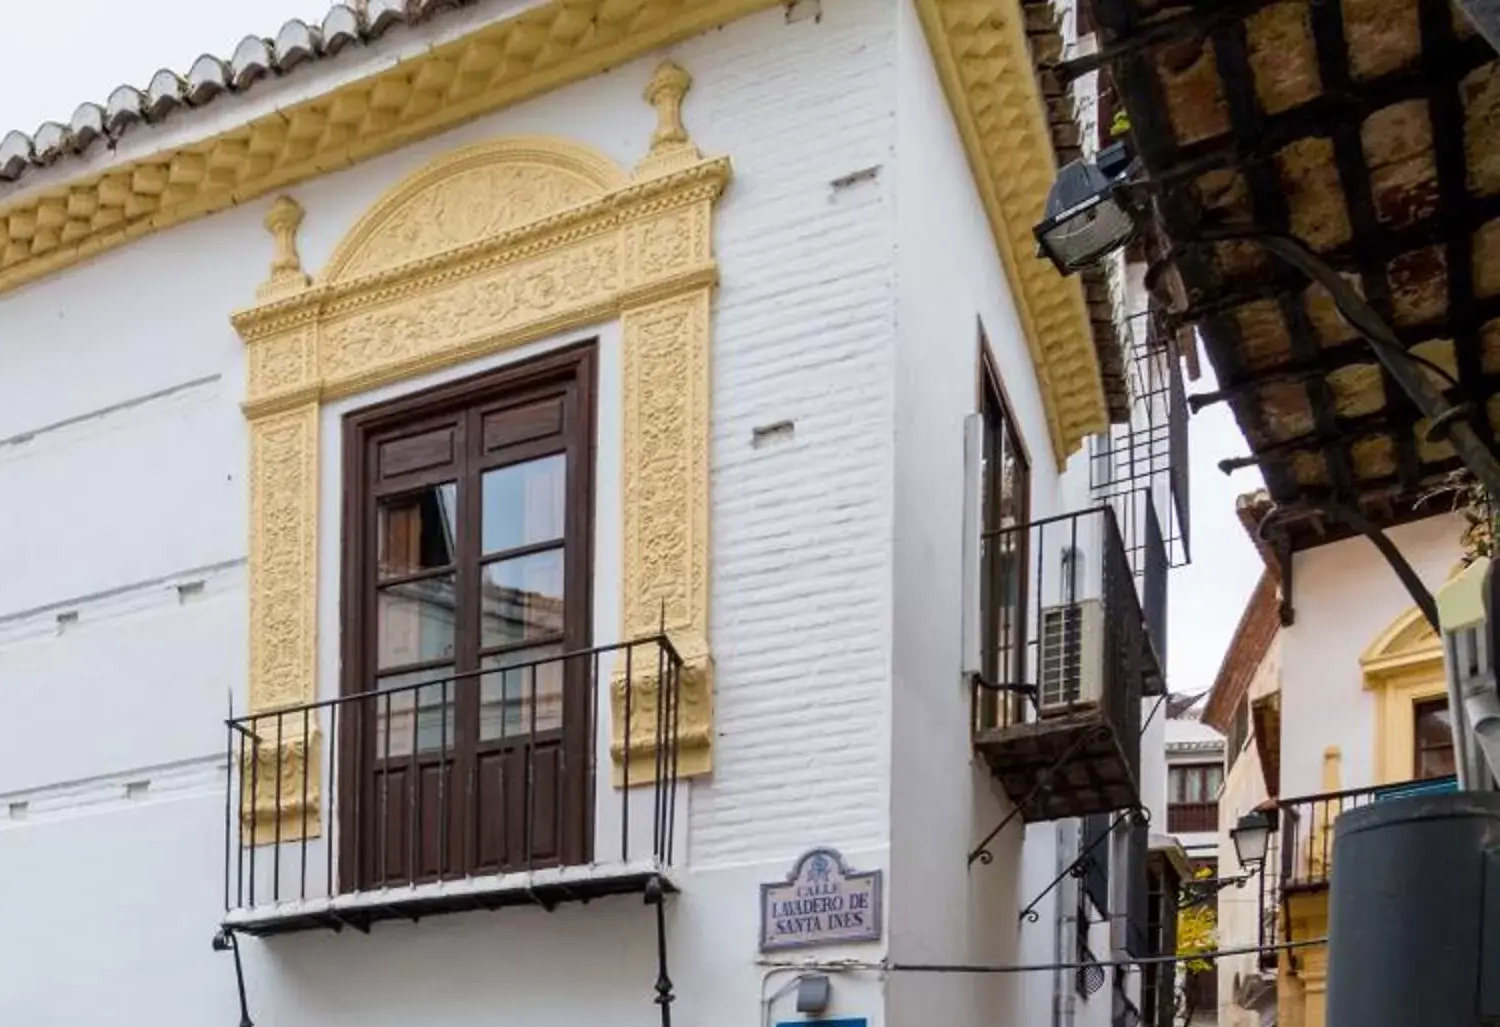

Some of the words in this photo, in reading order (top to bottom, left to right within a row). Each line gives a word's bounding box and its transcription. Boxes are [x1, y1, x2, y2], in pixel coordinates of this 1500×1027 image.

[797, 883, 838, 898] CALLE
[772, 895, 844, 919] LAVADERO
[849, 892, 869, 910] DE
[775, 915, 822, 935] SANTA
